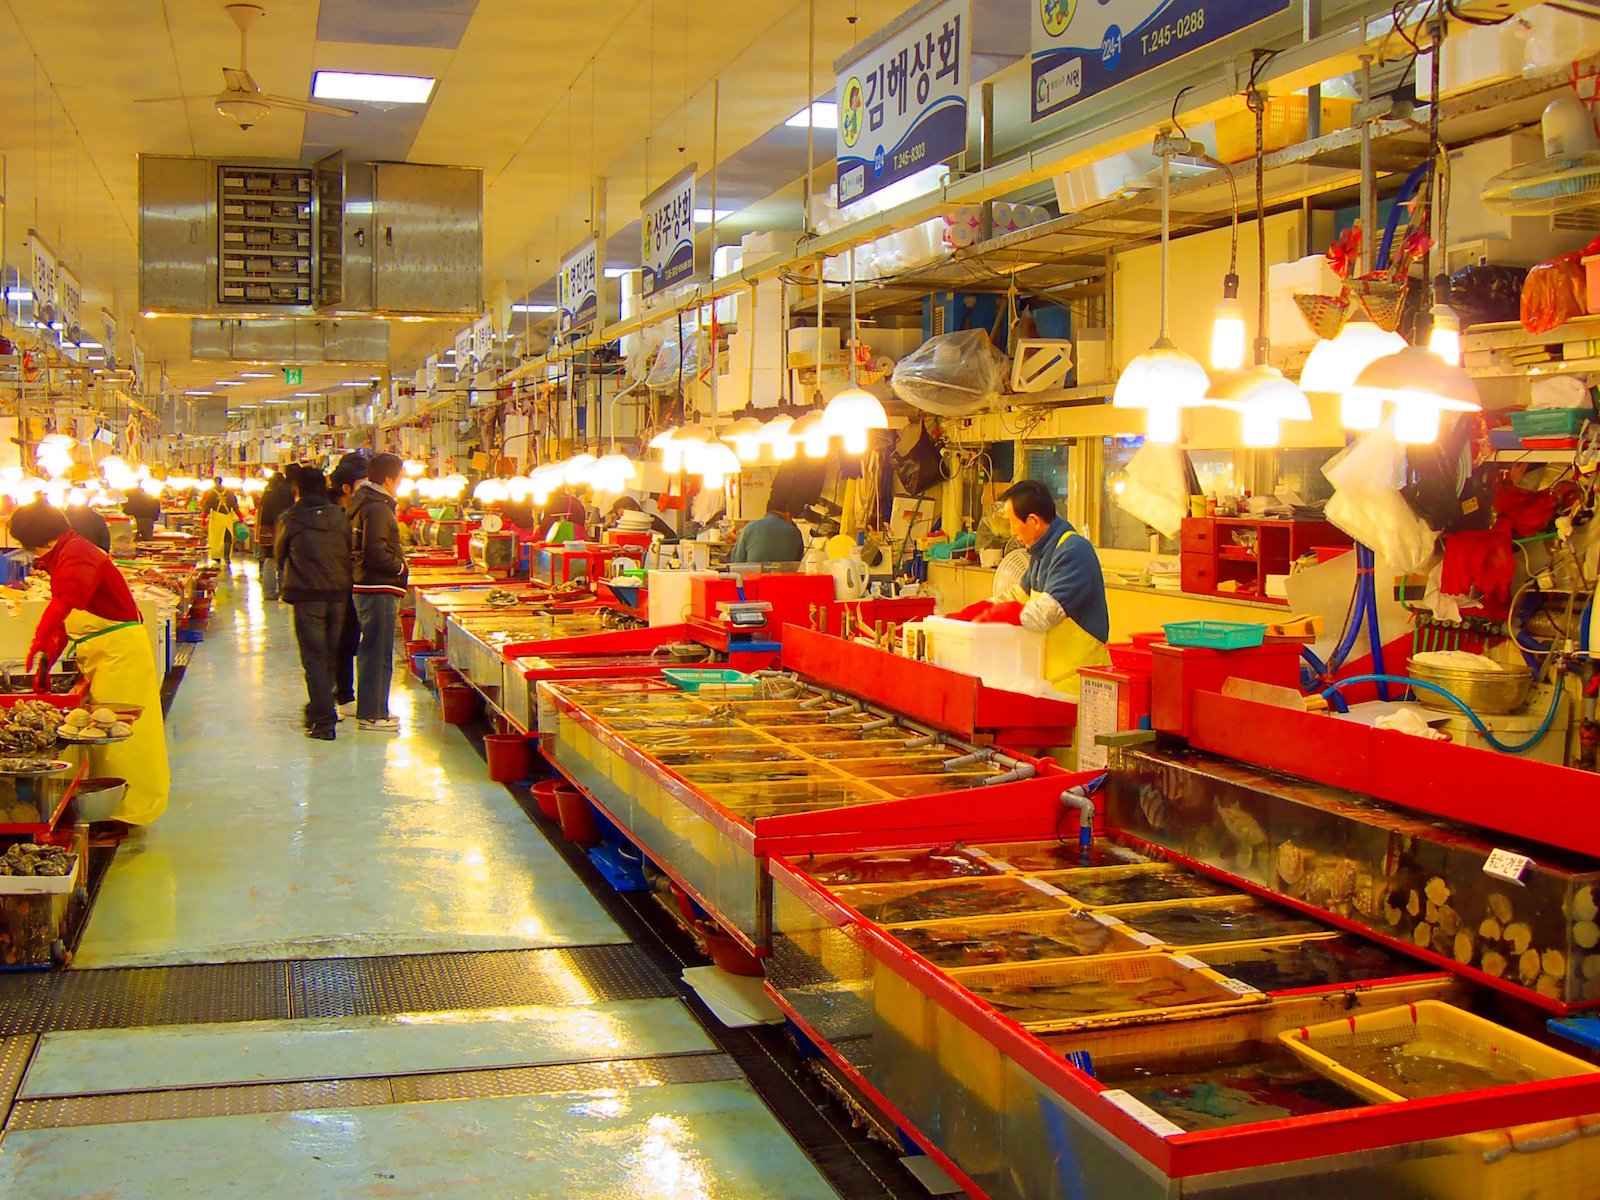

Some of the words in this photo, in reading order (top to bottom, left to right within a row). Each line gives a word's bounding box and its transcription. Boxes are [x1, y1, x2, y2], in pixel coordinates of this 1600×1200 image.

[1102, 33, 1122, 61] 224-1
[1141, 8, 1205, 56] T.245-0288
[864, 13, 961, 132] 김해상회
[654, 187, 691, 252] 상주상회
